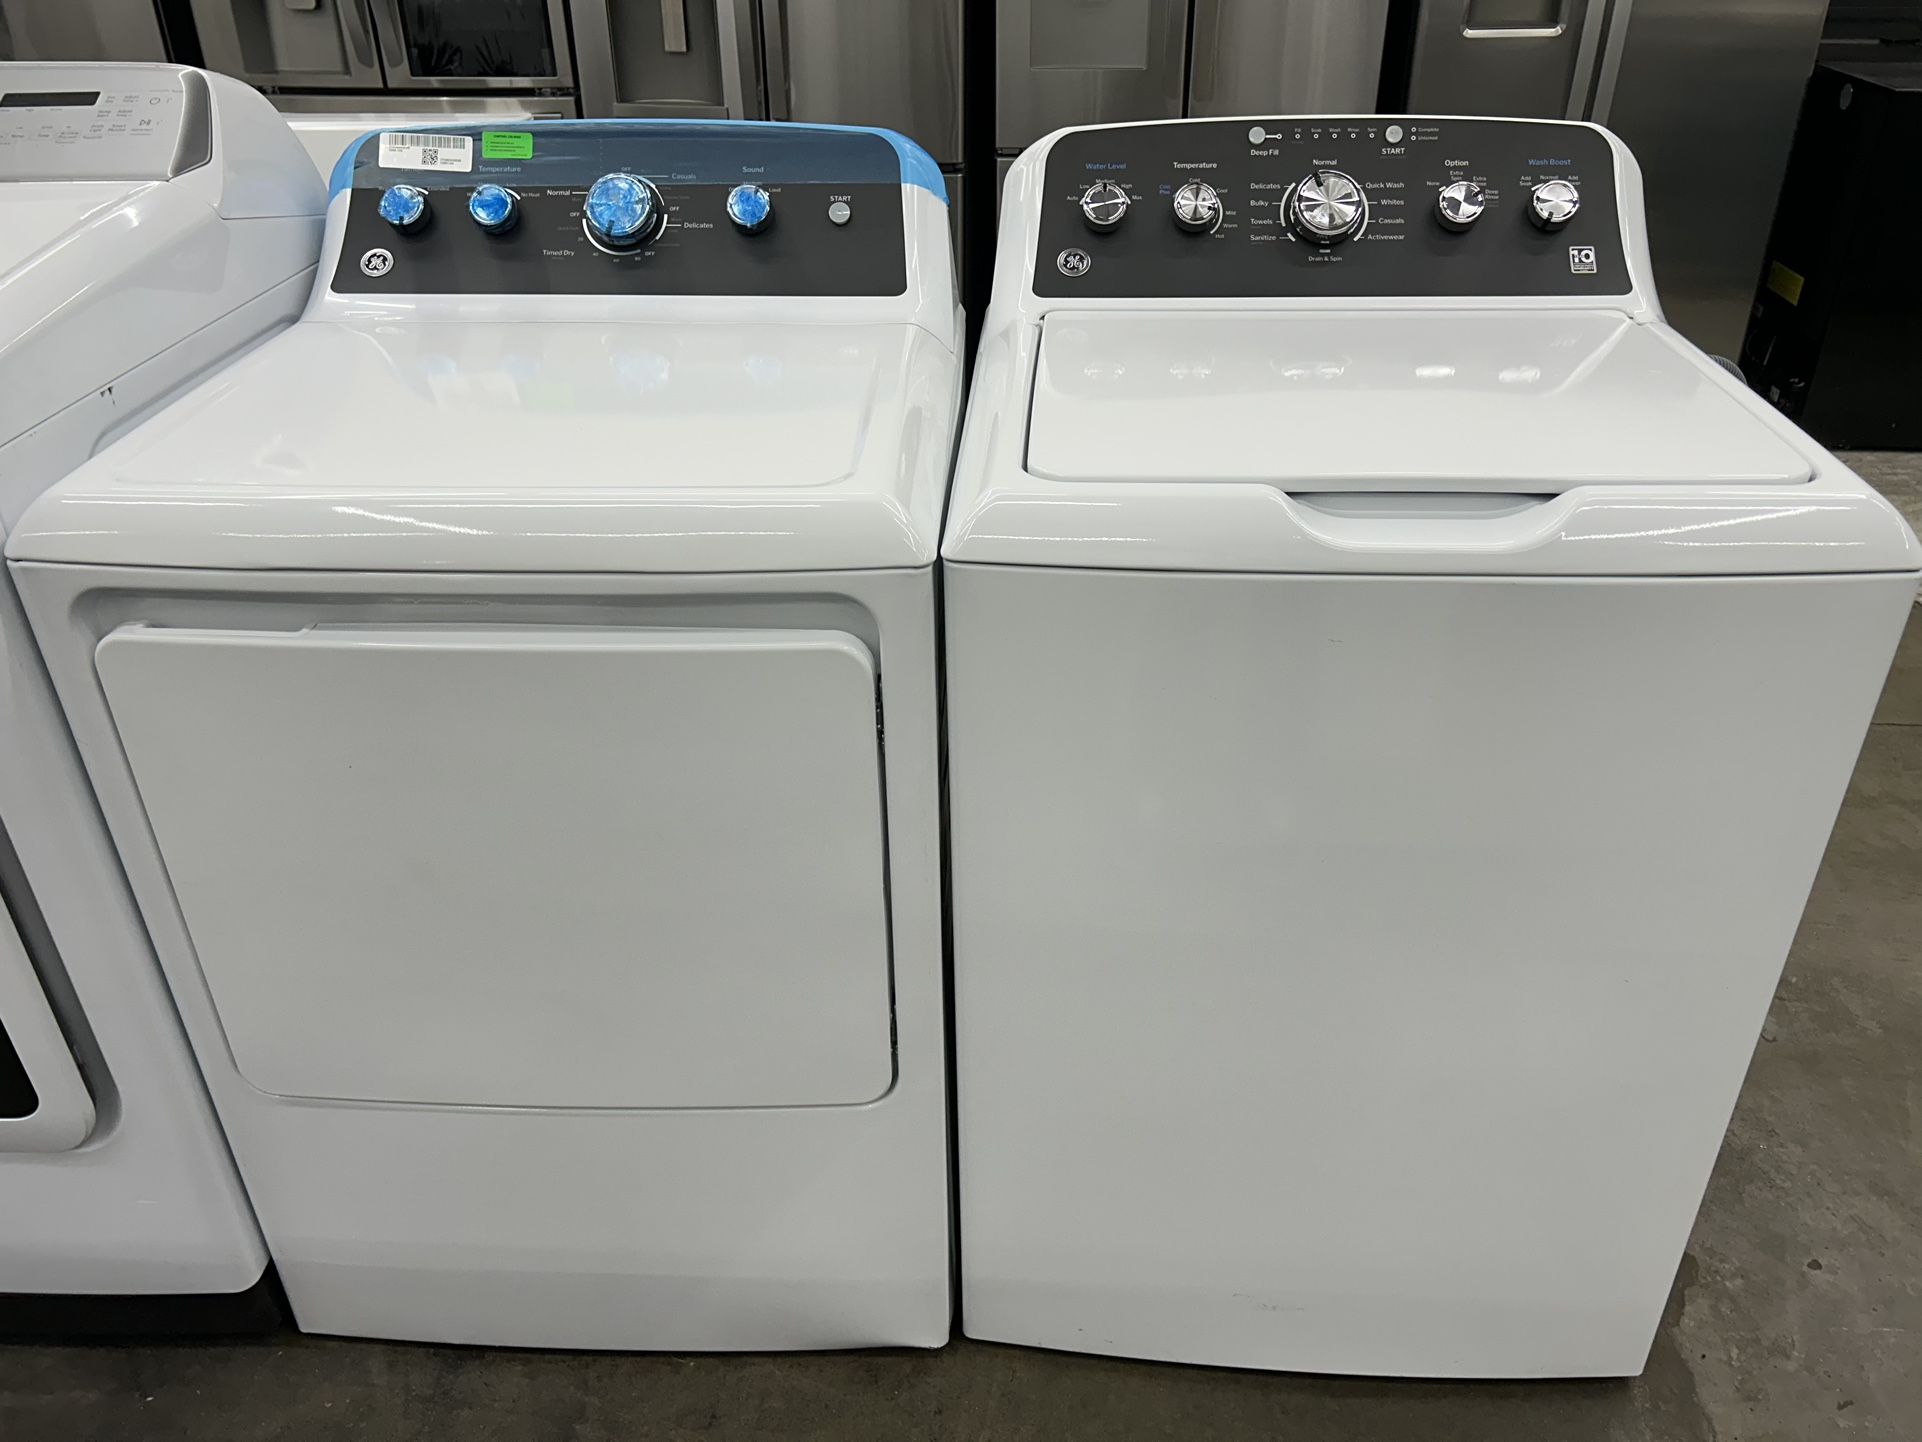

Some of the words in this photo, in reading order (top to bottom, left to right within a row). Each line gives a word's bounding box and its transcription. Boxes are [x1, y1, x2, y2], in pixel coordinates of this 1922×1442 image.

[479, 165, 521, 173] Temperature
[1173, 162, 1217, 170] Temperature
[1570, 250, 1594, 262] 10
